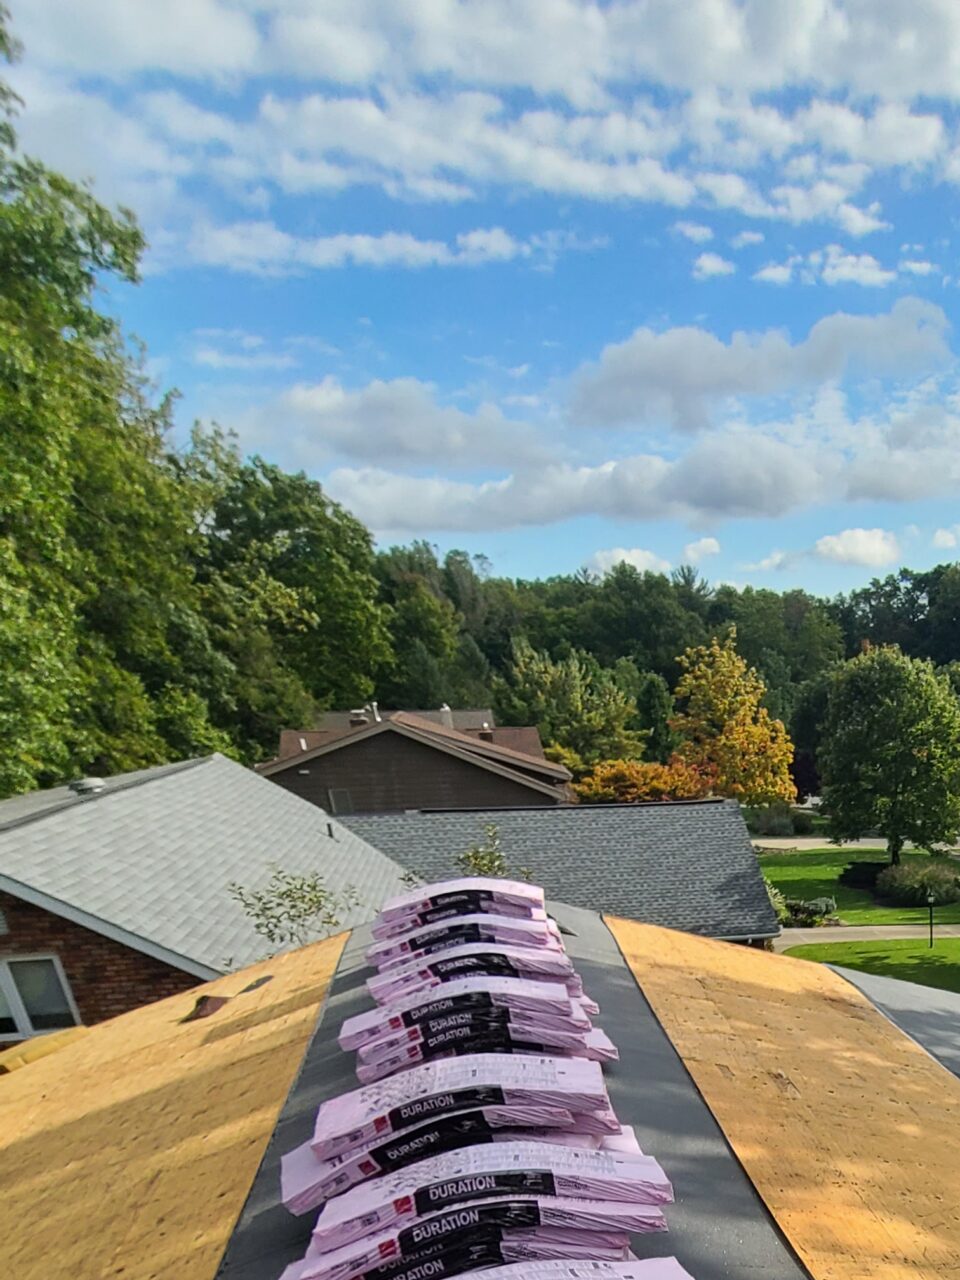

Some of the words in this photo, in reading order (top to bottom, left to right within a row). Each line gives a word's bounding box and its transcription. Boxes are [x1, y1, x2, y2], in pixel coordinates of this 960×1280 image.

[429, 1012, 472, 1032] DURATION
[401, 1095, 455, 1119] DURATION
[429, 1176, 496, 1200] DURATION
[412, 1209, 480, 1242] DURATION
